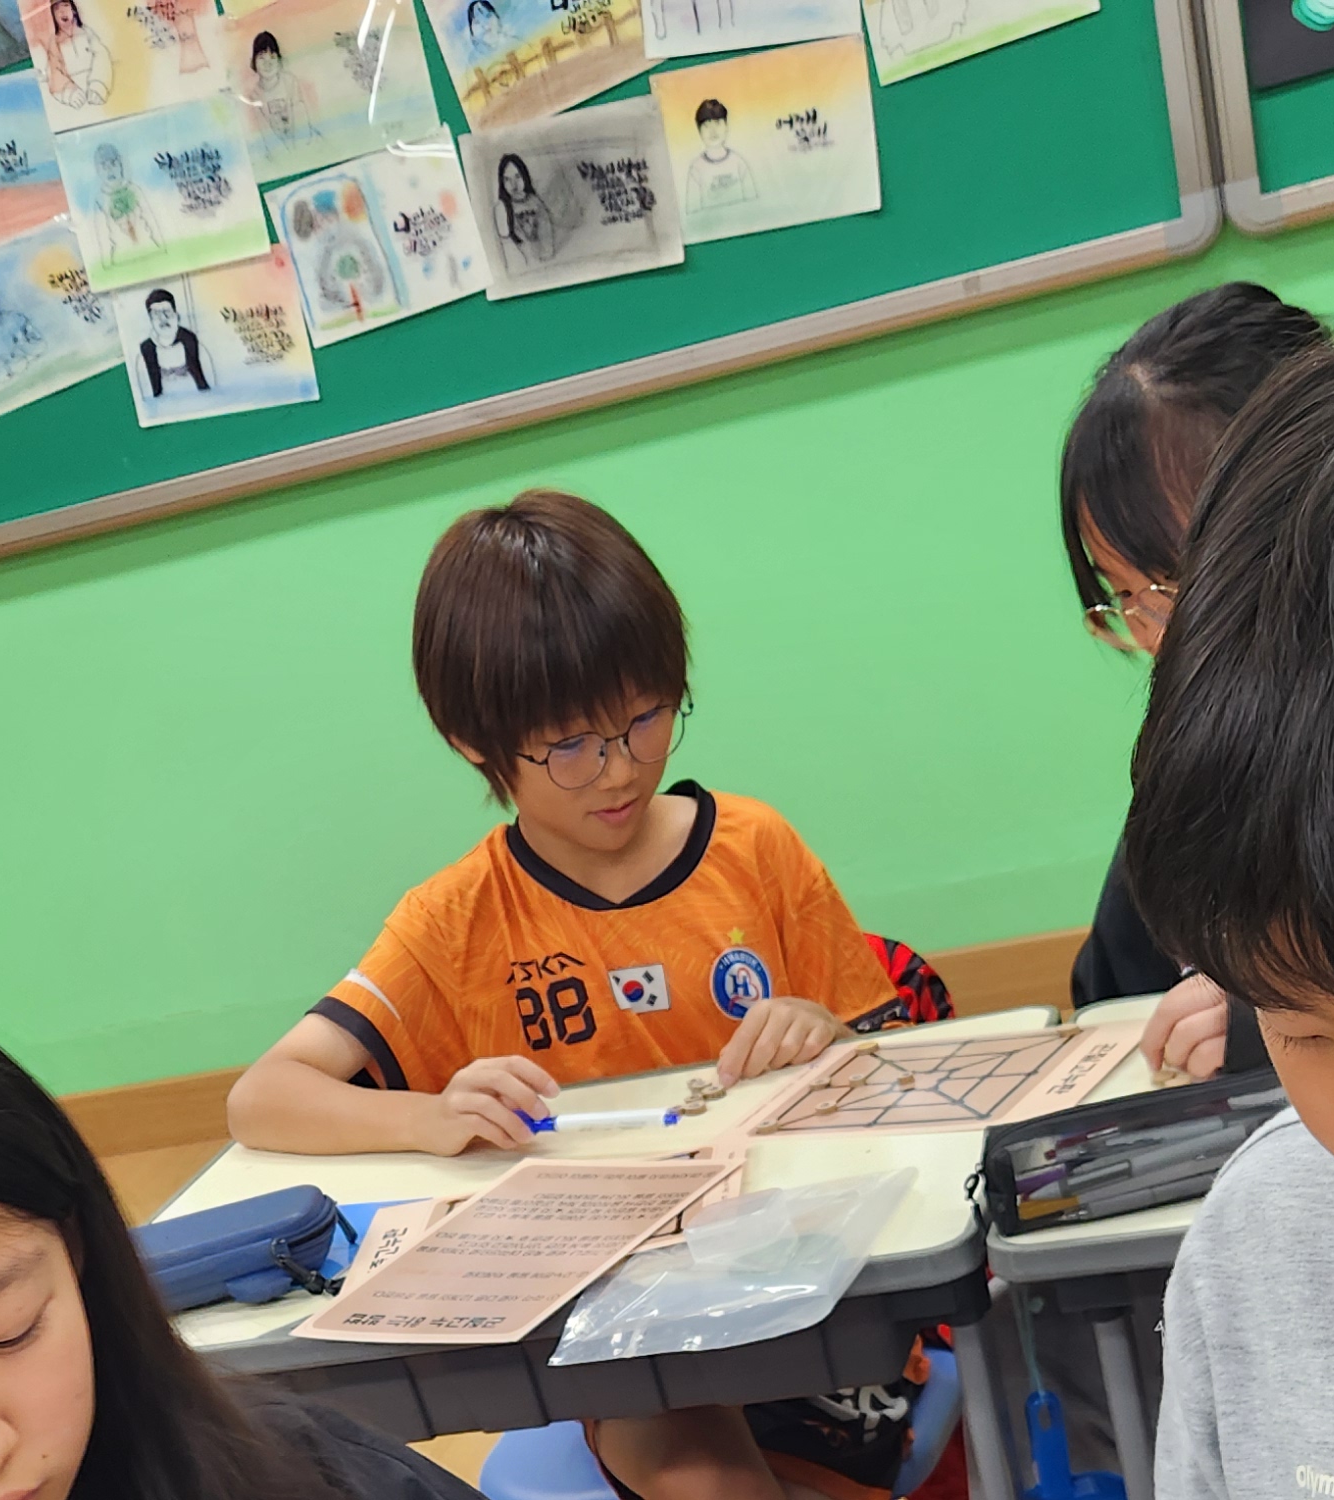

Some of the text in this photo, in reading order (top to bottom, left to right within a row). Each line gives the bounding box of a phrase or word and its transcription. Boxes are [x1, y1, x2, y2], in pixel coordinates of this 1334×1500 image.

[515, 976, 598, 1051] 88
[342, 1312, 386, 1328] 방법
[386, 1315, 427, 1329] 하는
